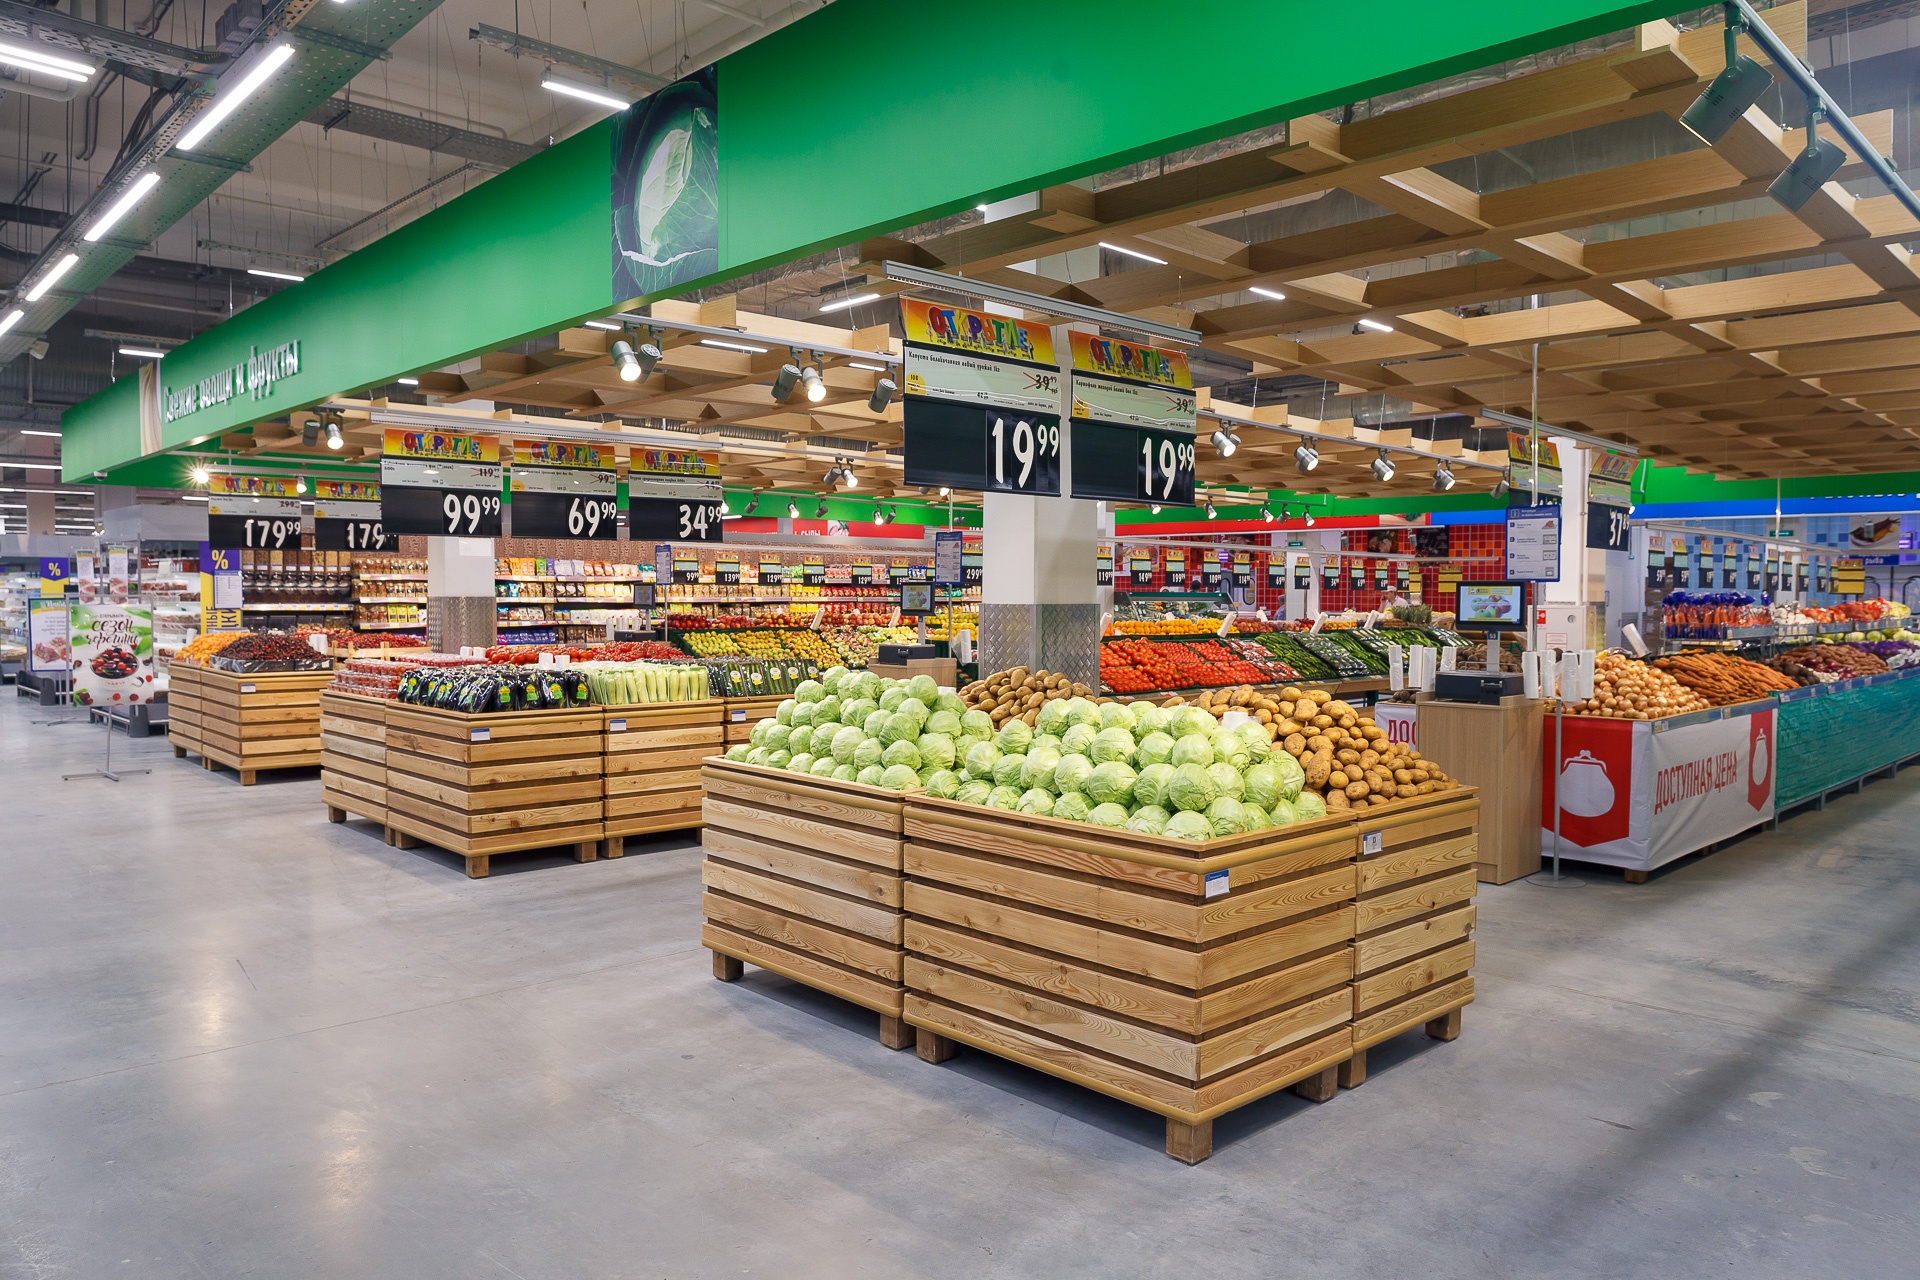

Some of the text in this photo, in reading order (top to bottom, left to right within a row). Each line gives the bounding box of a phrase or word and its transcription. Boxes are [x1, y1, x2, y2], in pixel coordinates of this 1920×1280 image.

[929, 307, 1028, 351] ОТКРЫТИЕ
[1090, 338, 1169, 378] ОТКРЫТИЕ
[164, 340, 298, 423] Свежие овощи и фрукты
[404, 432, 480, 454] ОТКРЫТИЕ
[531, 443, 598, 463] ОТКРЫТИЕ
[645, 450, 704, 469] ОТКРЫТИЕ
[226, 477, 284, 493] ОТКРЫТИЕ
[1654, 750, 1738, 815] ДОСТУПНАЯ ЦЕНА
